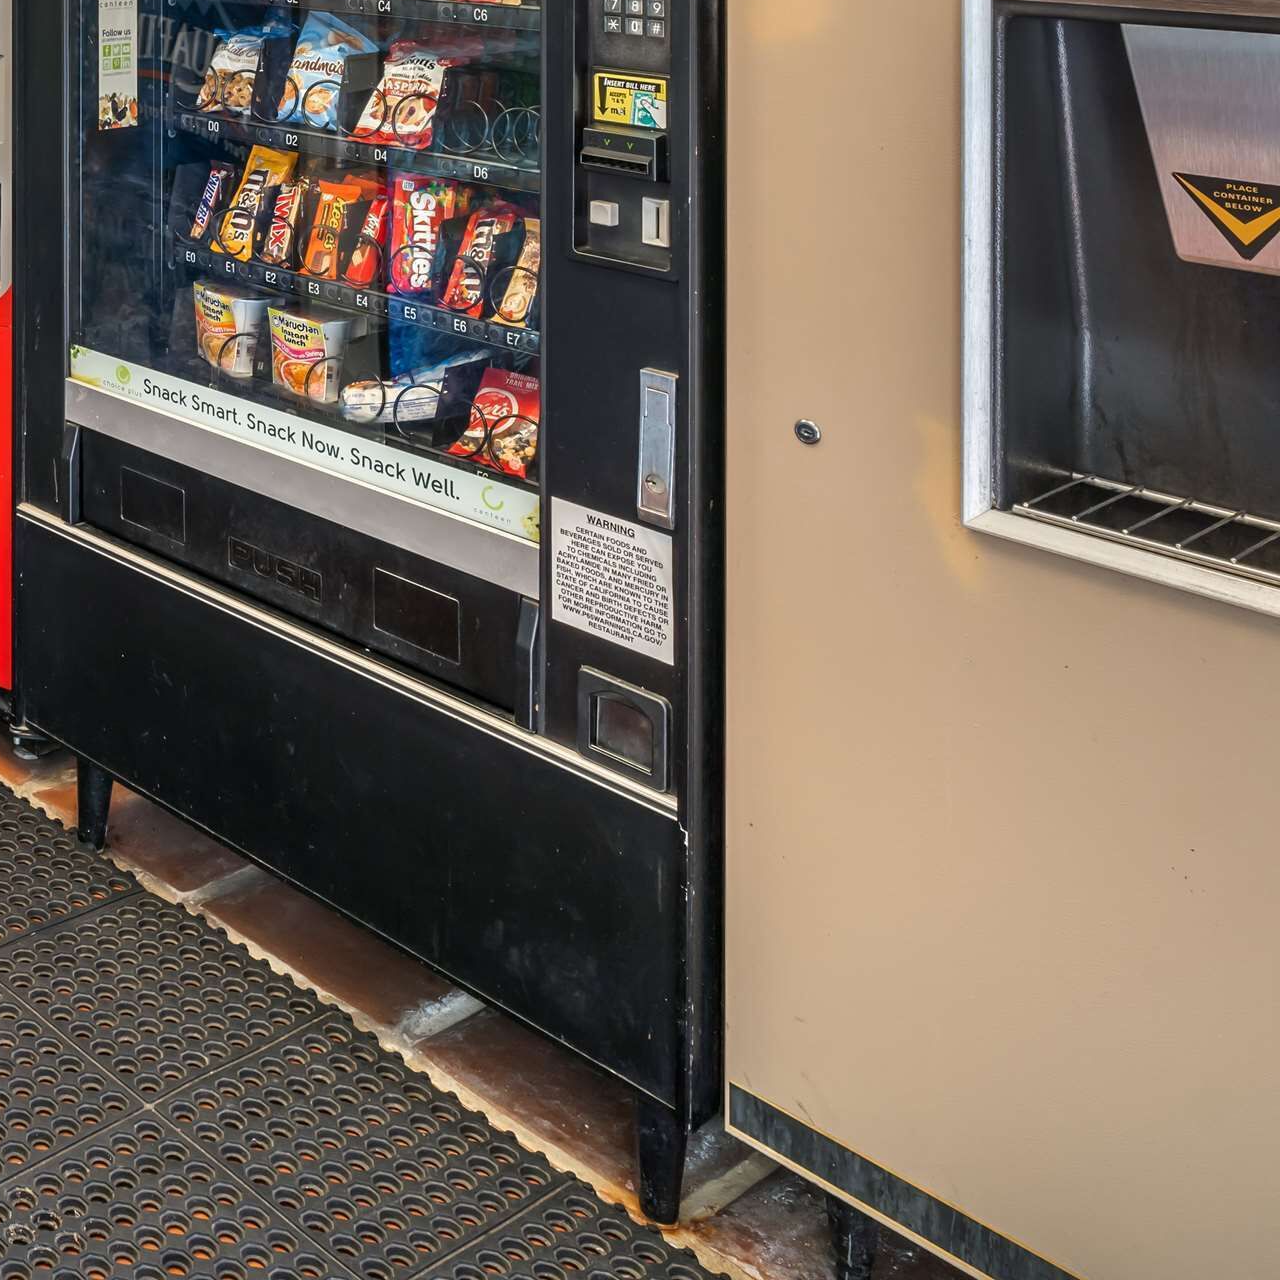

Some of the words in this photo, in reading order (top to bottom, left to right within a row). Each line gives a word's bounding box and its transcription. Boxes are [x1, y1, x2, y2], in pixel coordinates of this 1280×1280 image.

[378, 0, 390, 12] C4
[473, 8, 488, 20] C6
[604, 78, 625, 88] INSERT
[626, 80, 638, 89] BILL
[640, 82, 656, 92] HERE
[208, 121, 220, 132] D0
[285, 134, 298, 146] D2
[374, 149, 387, 161] D4
[474, 166, 488, 179] D6
[1226, 183, 1259, 193] PLACE
[1214, 191, 1273, 205] CONTAINER
[1225, 201, 1262, 212] BELOW
[269, 187, 297, 249] TWIX
[410, 192, 436, 288] Skittles
[186, 251, 196, 262] E0
[225, 262, 235, 273] E1
[265, 272, 276, 283] E2
[308, 282, 319, 294] E3
[356, 295, 368, 307] E4
[404, 306, 416, 319] E5
[279, 315, 319, 335] Maruchan
[454, 319, 466, 332] E6
[281, 327, 309, 340] Instant
[506, 332, 520, 346] E7
[284, 336, 306, 347] Lunch
[506, 378, 523, 387] TRAIL
[526, 382, 539, 390] MIX
[144, 378, 187, 408] Snack
[192, 395, 242, 425] Smart.
[247, 414, 296, 444] Snack
[301, 433, 344, 462] Now.
[351, 447, 406, 482] Snack
[412, 467, 460, 502] Well.
[473, 507, 512, 525] canteen
[586, 514, 635, 538] WARNING
[575, 526, 605, 541] CERTAIN
[606, 536, 630, 549] FOODS
[632, 545, 647, 555] AND
[560, 528, 601, 546] BEVERAGES
[603, 542, 621, 554] SOLD
[623, 550, 634, 559] OR
[635, 554, 663, 568] SERVED
[589, 622, 634, 643] RESTAURANT
